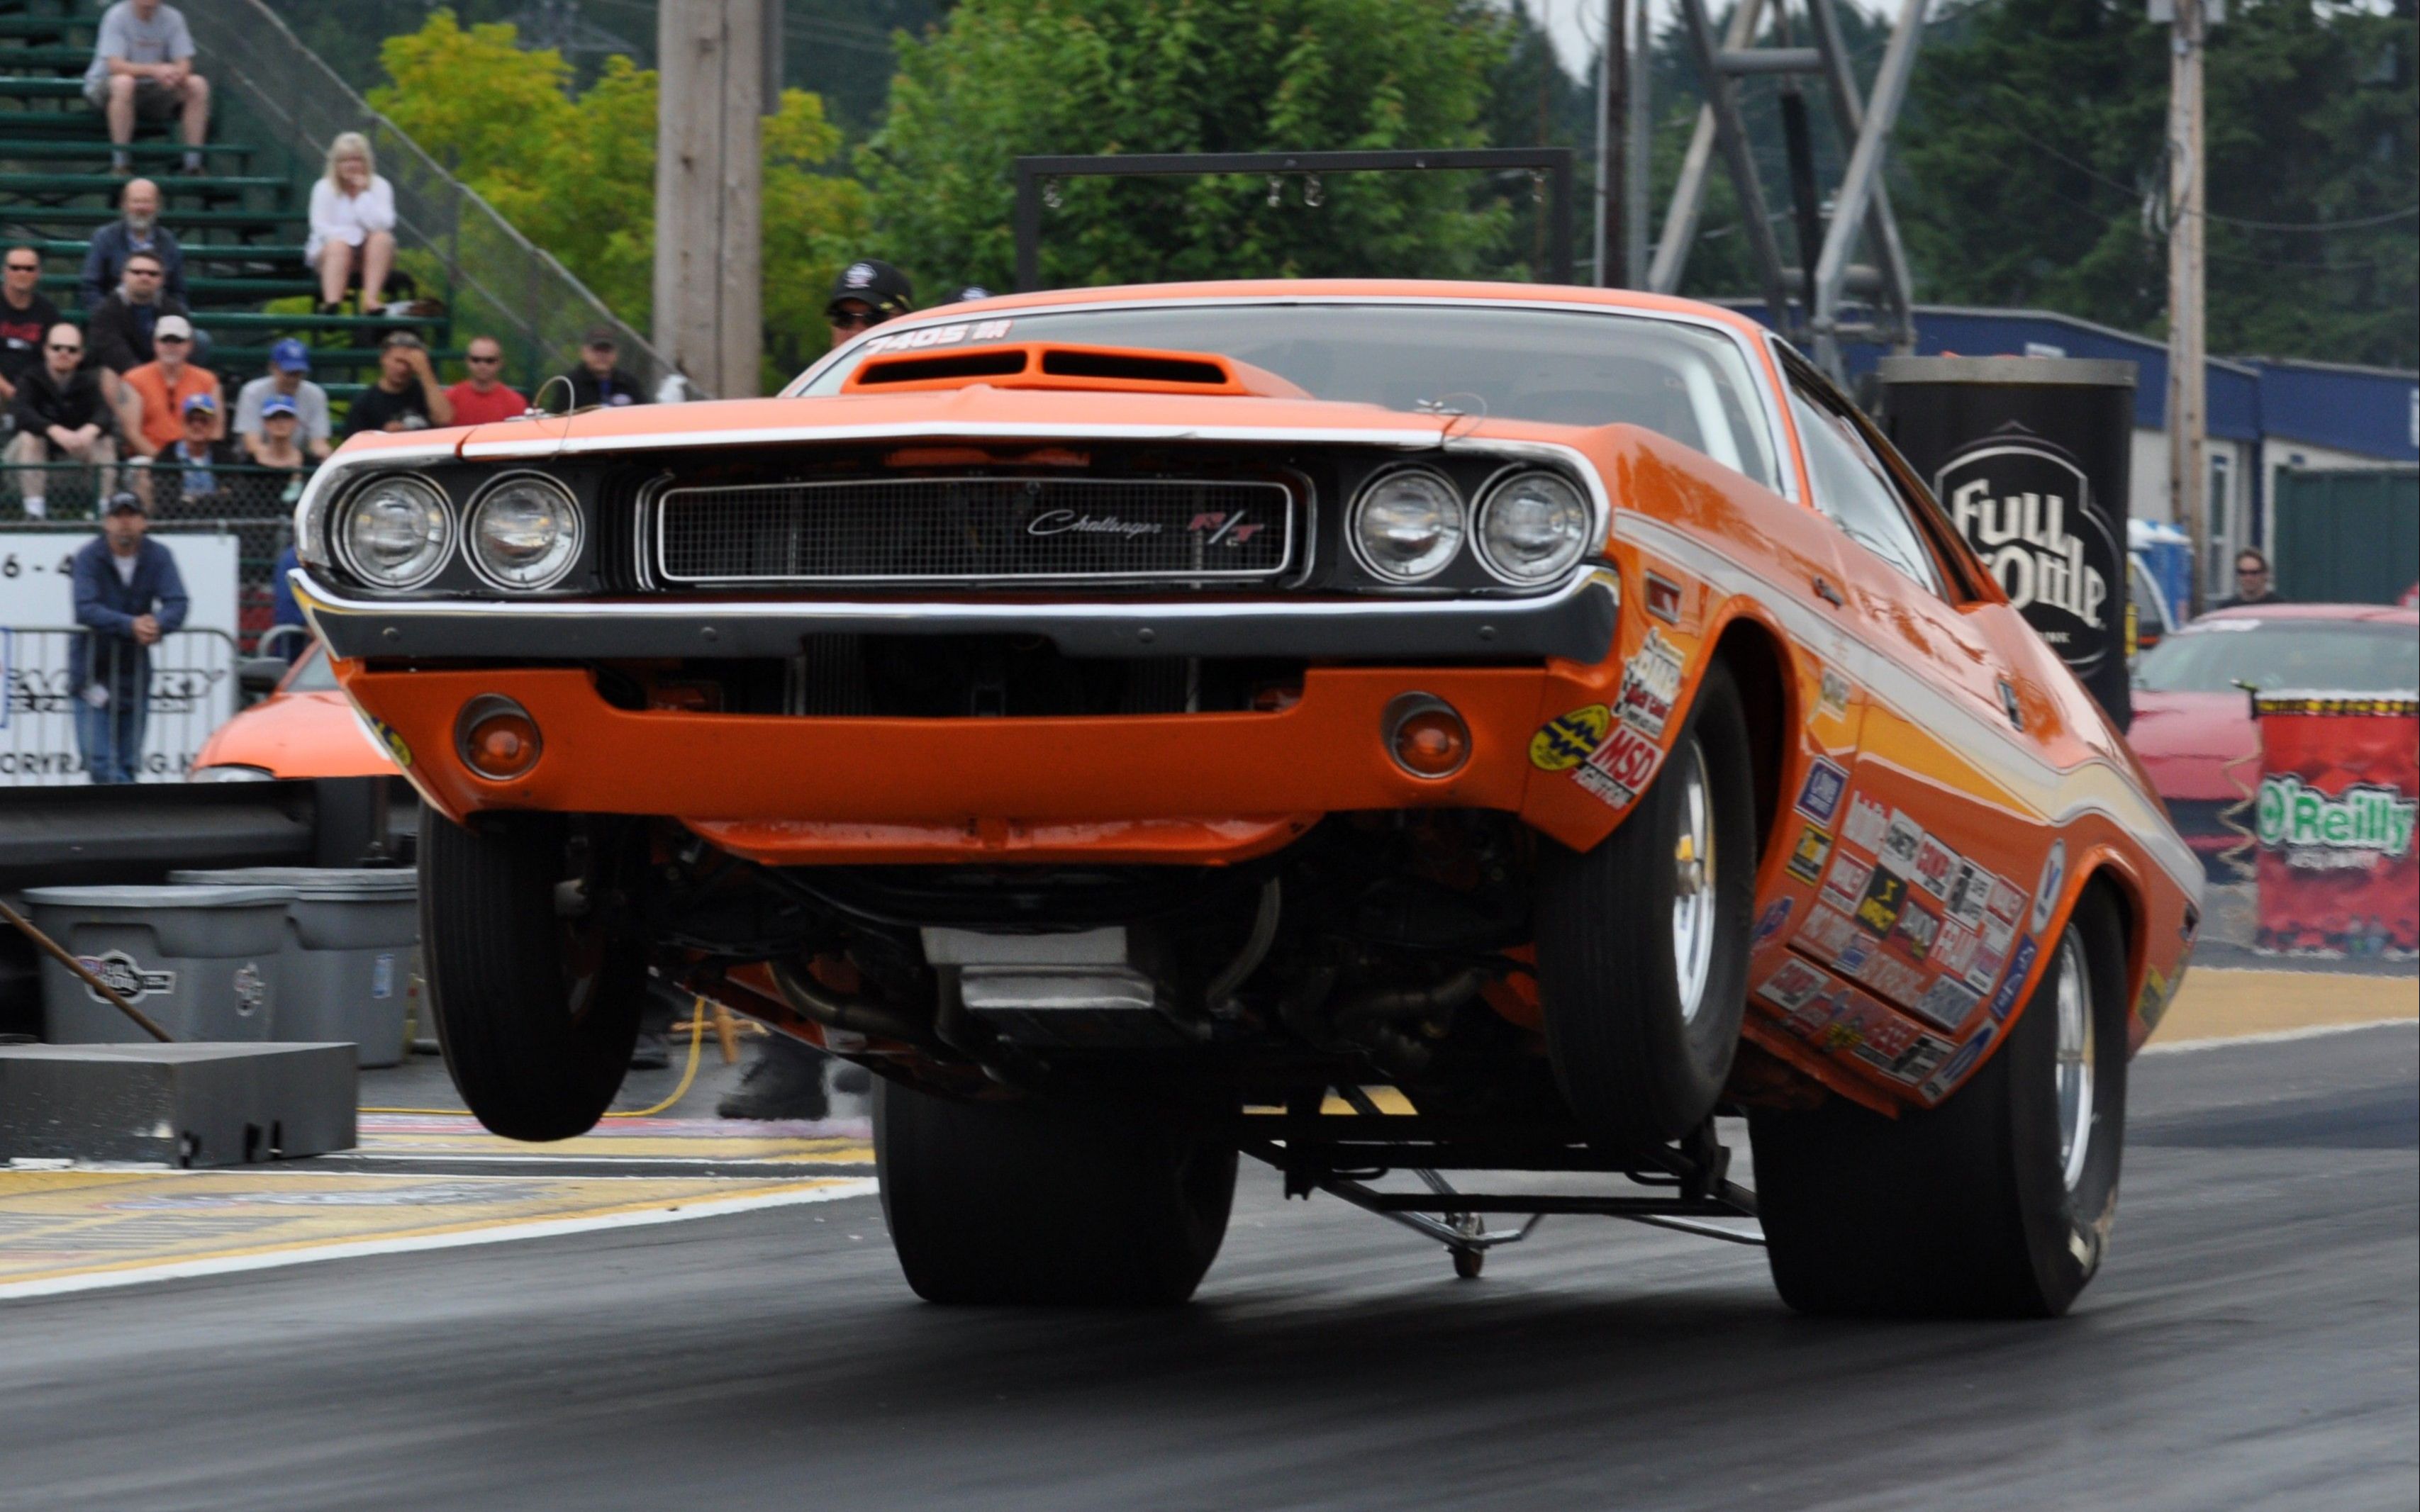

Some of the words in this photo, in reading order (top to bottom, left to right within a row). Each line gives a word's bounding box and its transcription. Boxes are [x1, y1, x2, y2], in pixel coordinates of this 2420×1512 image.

[1027, 509, 1161, 539] Challenger
[1188, 508, 1266, 544] R/T
[1592, 729, 1658, 789] MSD
[2258, 783, 2413, 851] O'Reilly
